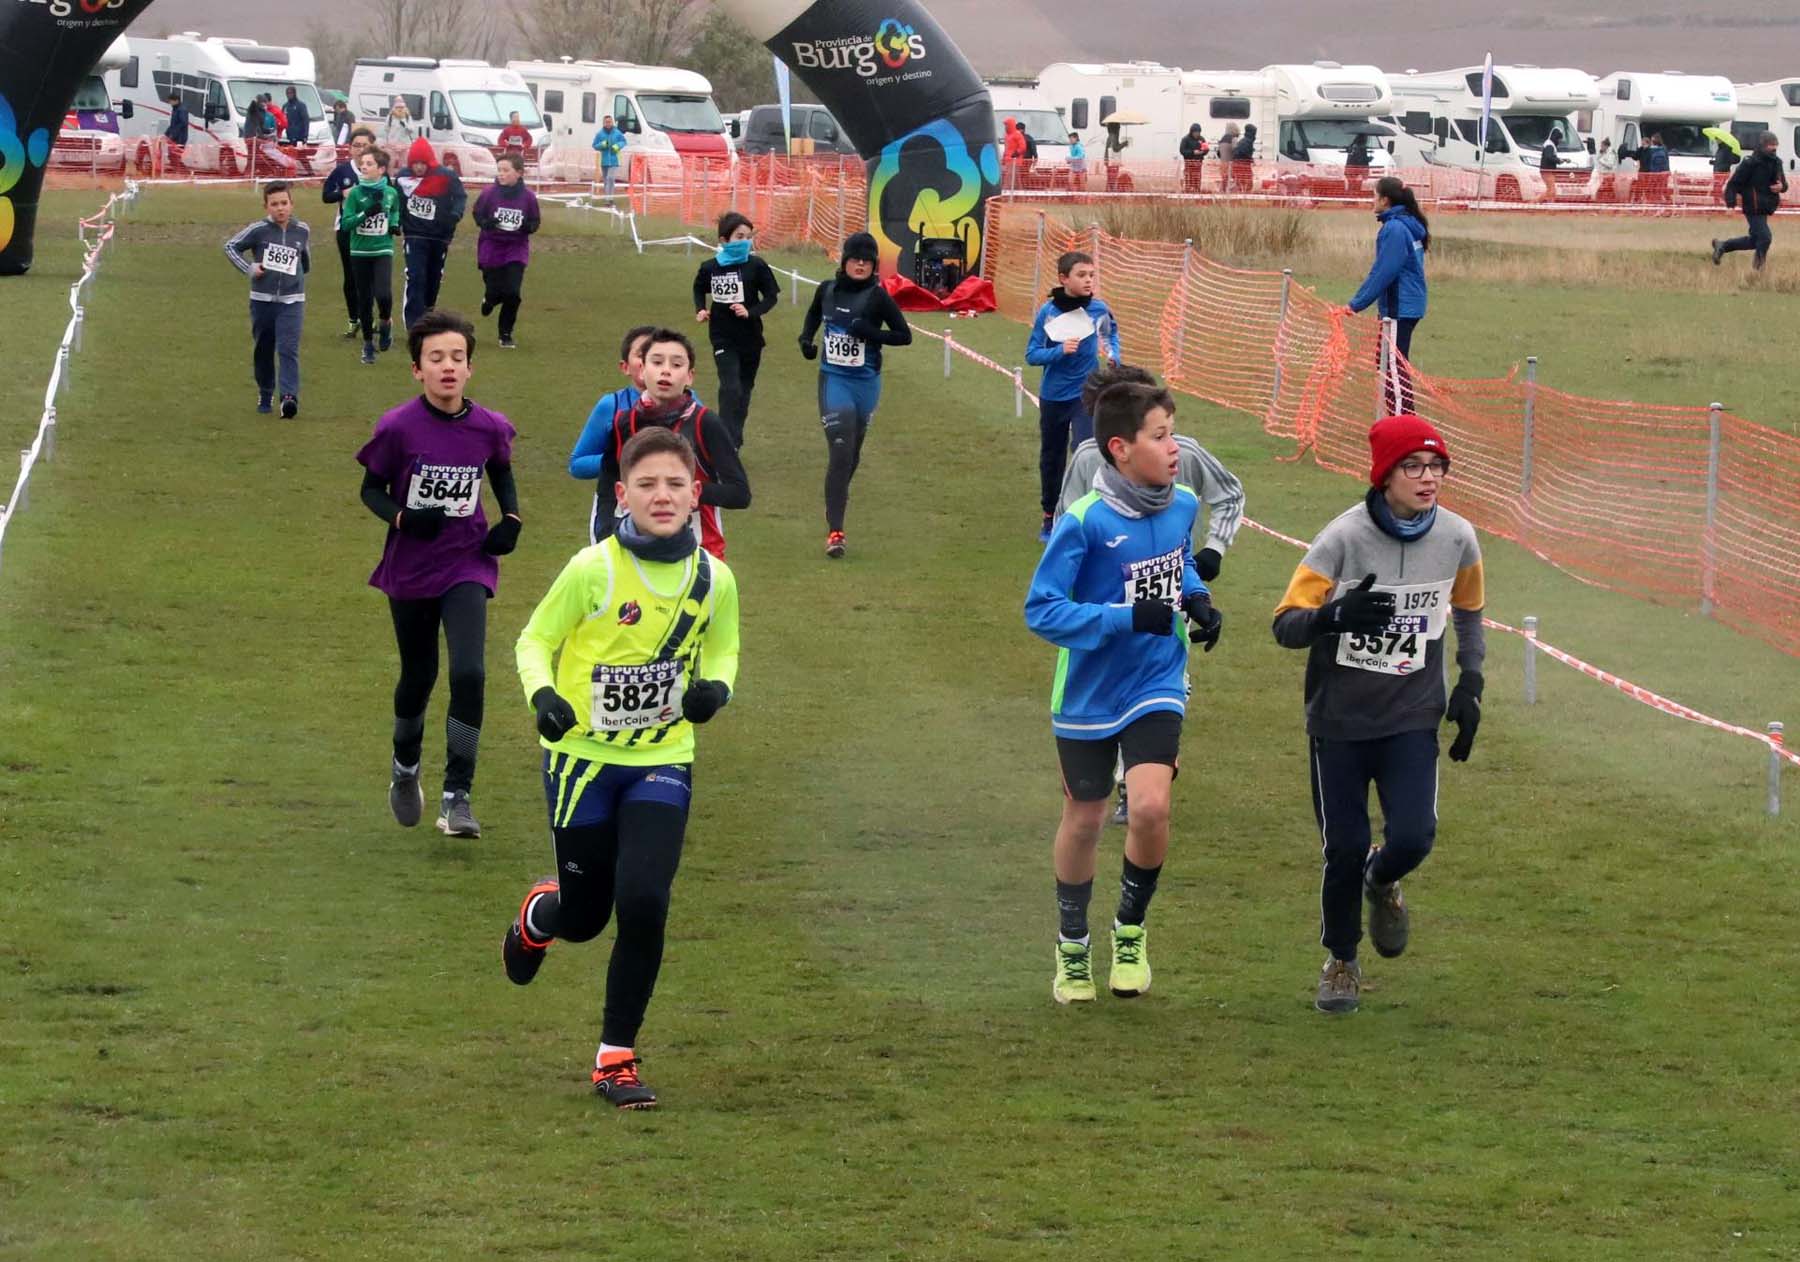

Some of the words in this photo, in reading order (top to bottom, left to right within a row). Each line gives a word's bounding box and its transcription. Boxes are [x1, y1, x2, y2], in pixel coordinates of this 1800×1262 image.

[815, 35, 862, 49] Provincia
[862, 35, 873, 43] de
[866, 75, 894, 87] origen
[902, 70, 932, 82] destino
[268, 250, 295, 266] 5697
[829, 341, 860, 357] 5196
[420, 470, 478, 480] BURGOS
[418, 479, 474, 502] 5644
[1134, 565, 1183, 601] 5579
[1403, 590, 1440, 610] 1975
[600, 661, 678, 675] DIPUTACIÓN
[600, 669, 678, 683] BURGOS
[603, 679, 676, 712] 5827
[601, 714, 649, 726] iberCaja
